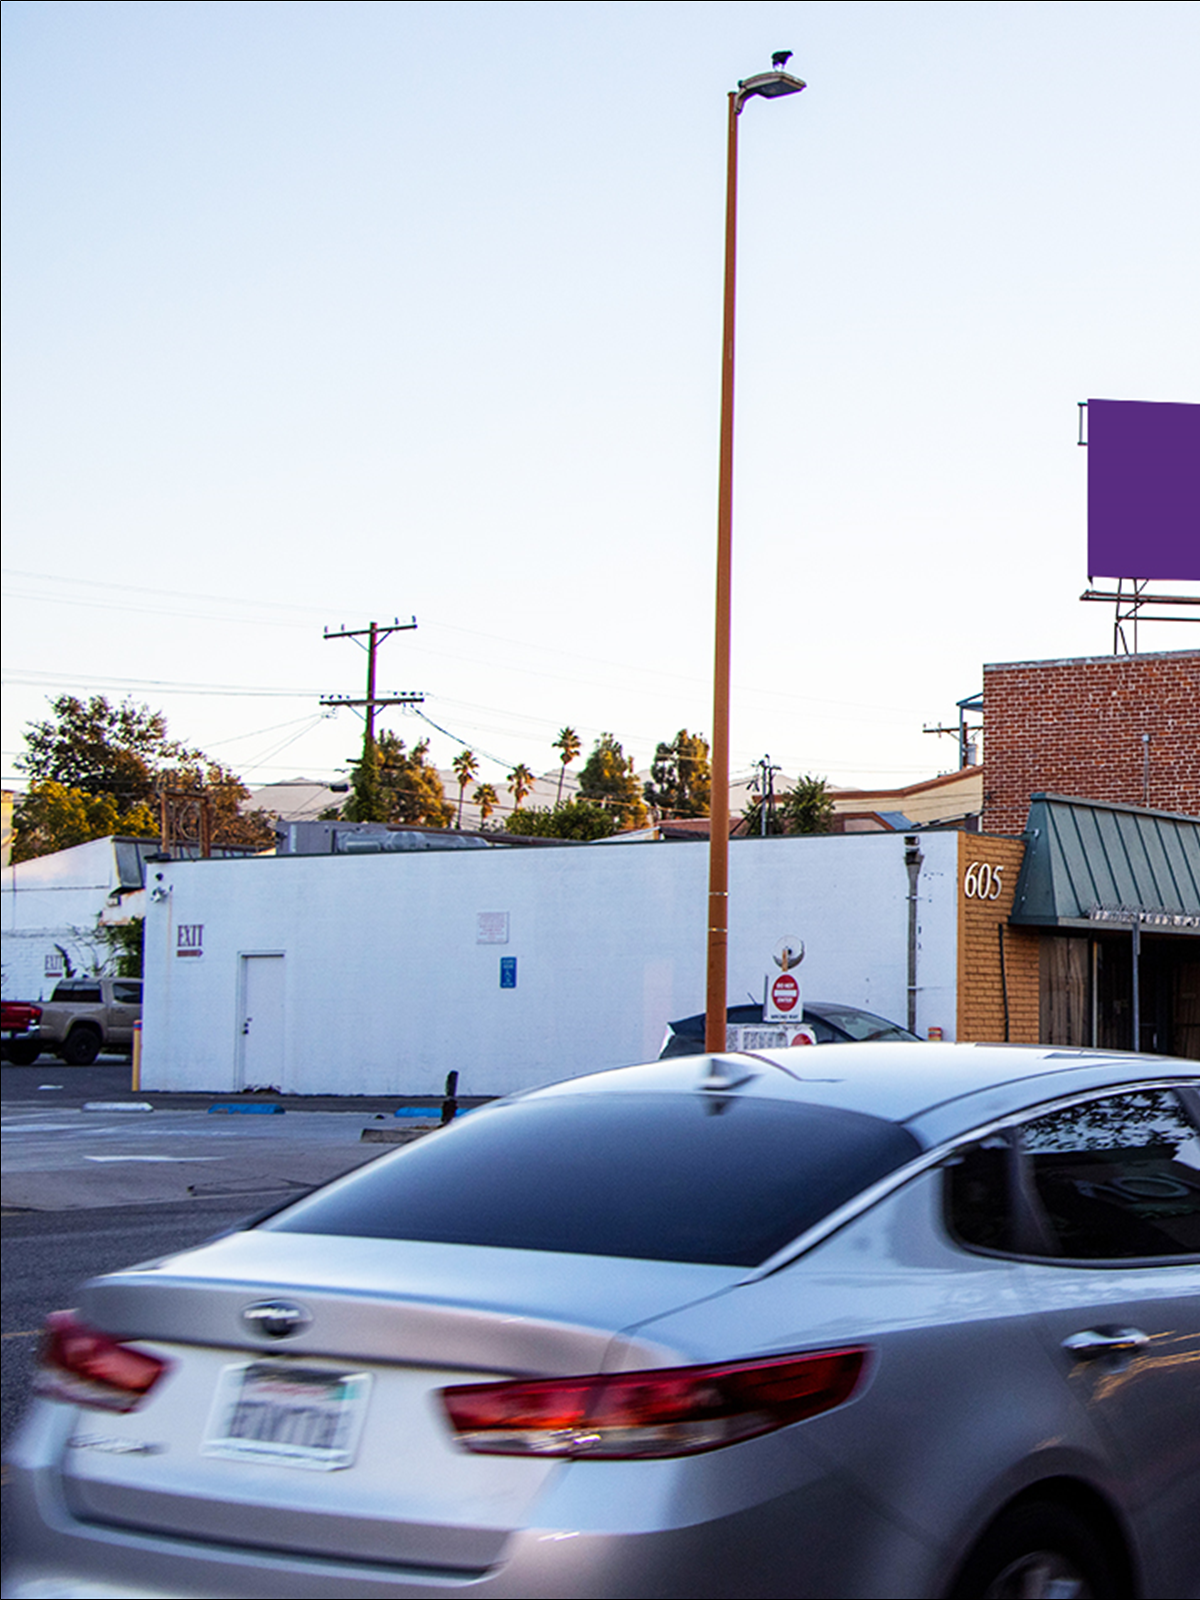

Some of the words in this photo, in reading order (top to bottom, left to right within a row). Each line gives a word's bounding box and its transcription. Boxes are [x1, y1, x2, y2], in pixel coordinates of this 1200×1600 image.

[964, 862, 1004, 900] 605
[177, 925, 203, 947] EXIT
[45, 954, 62, 970] EXIT
